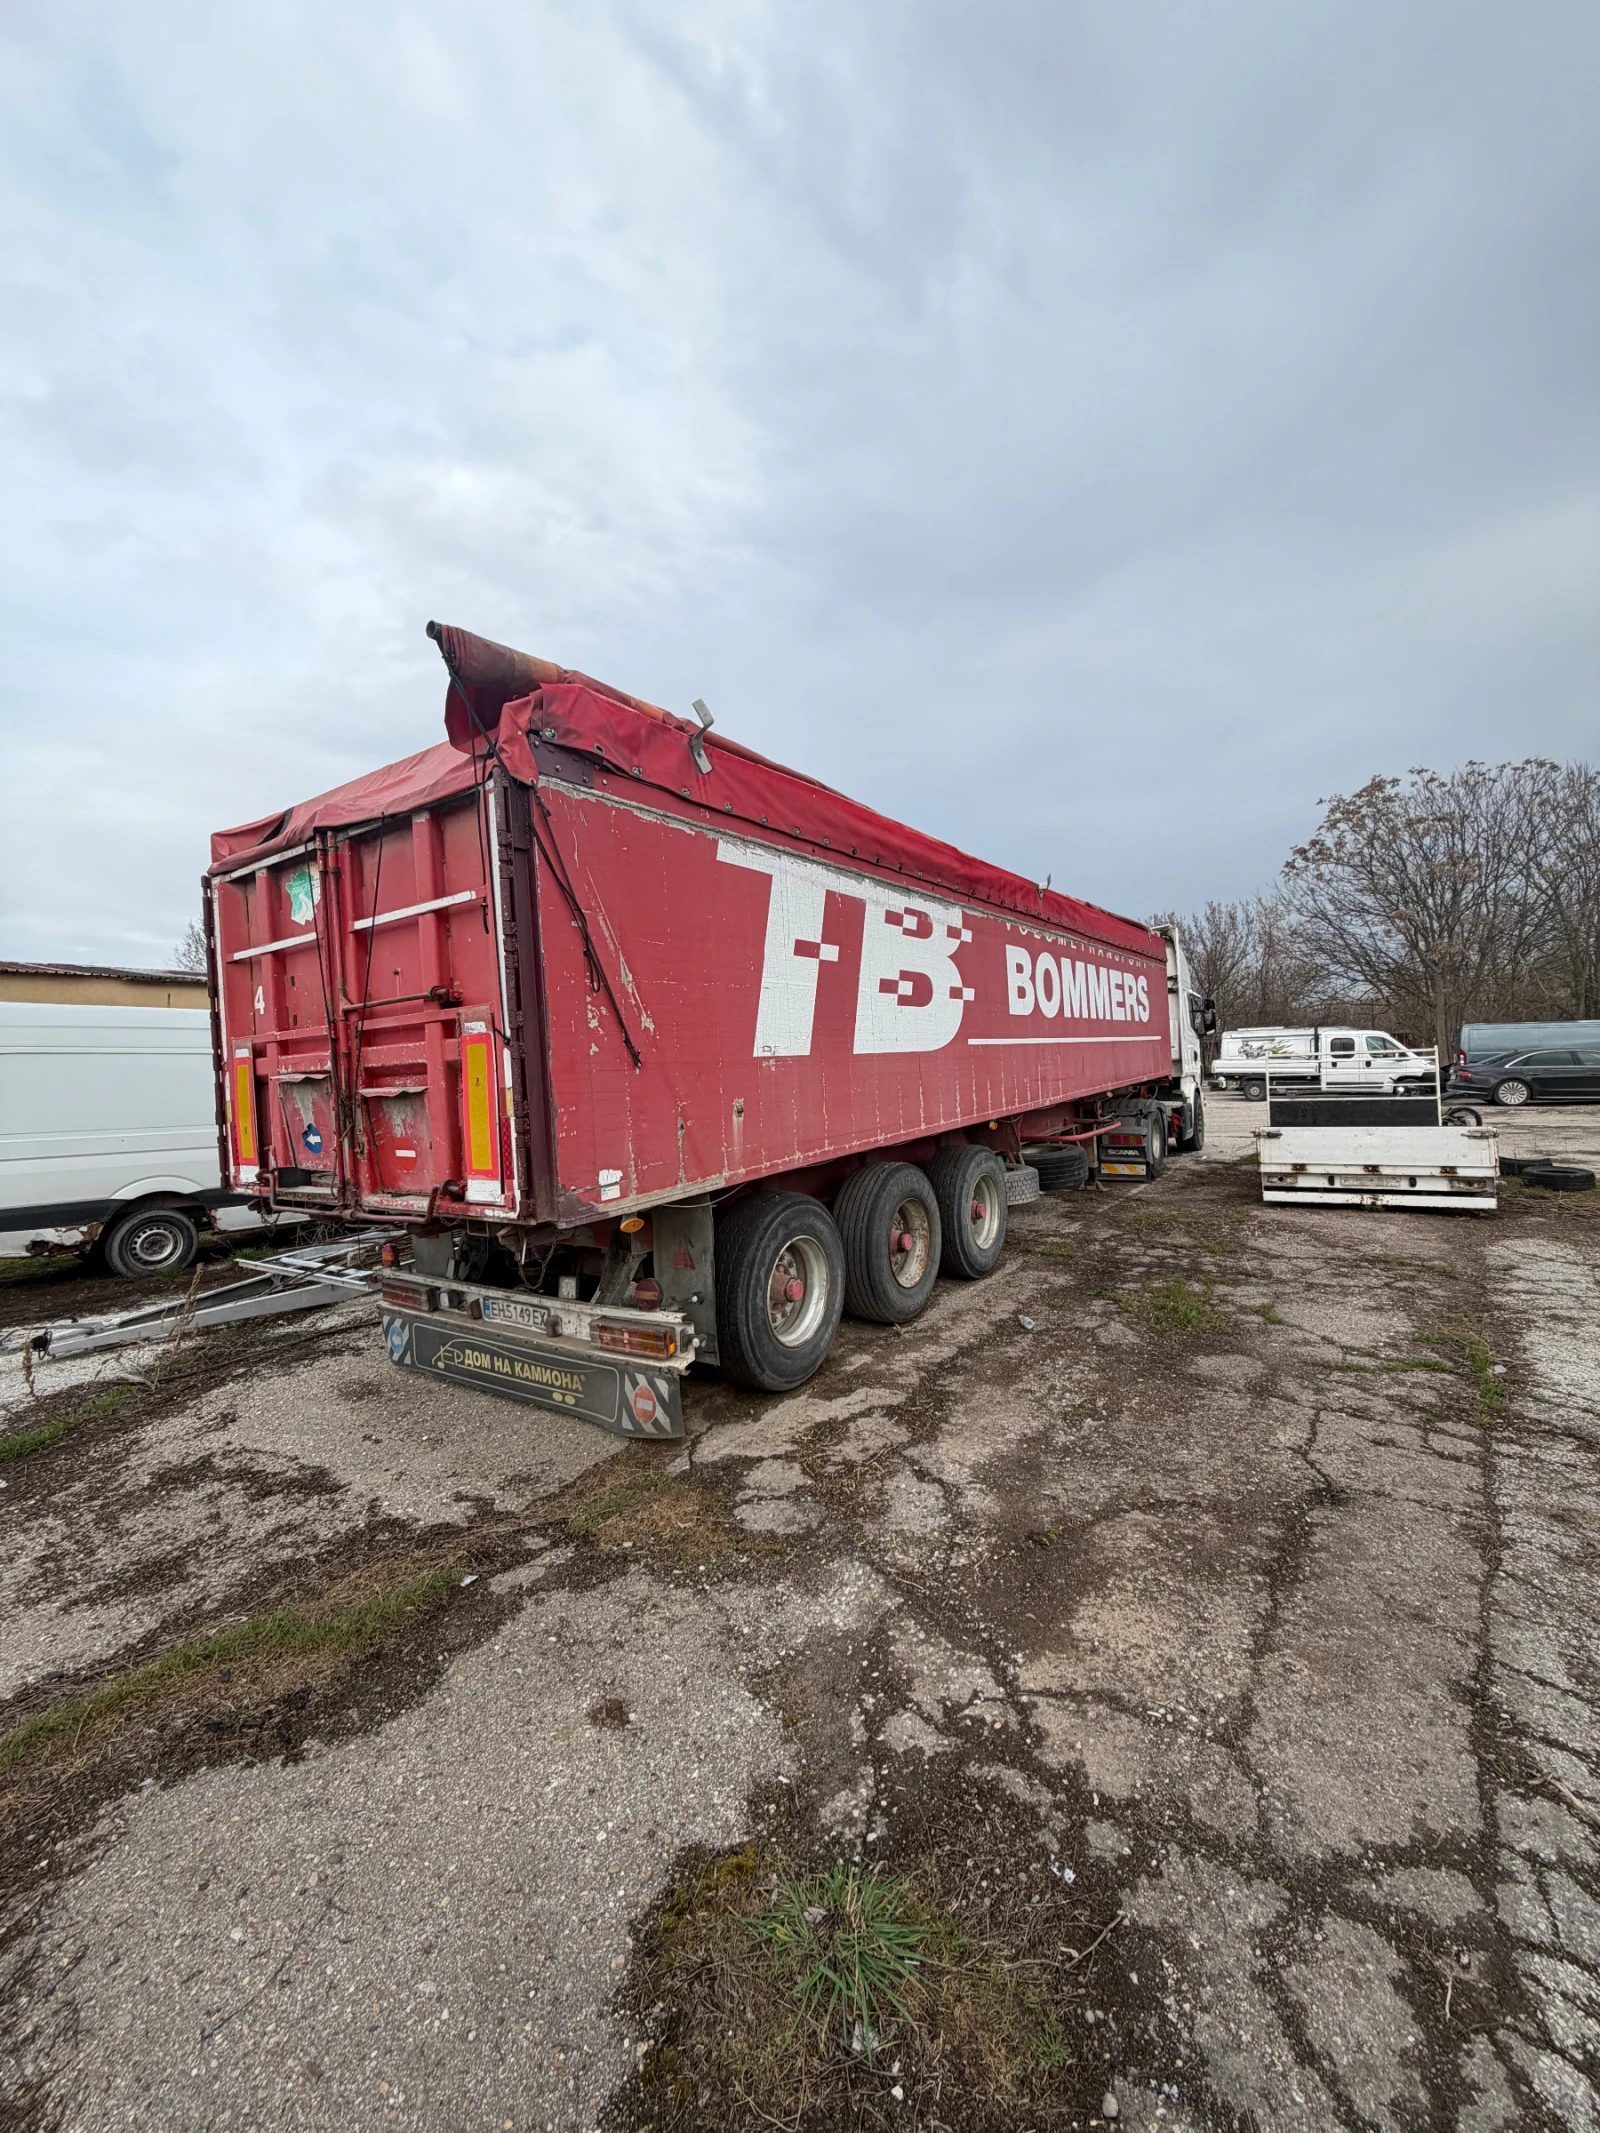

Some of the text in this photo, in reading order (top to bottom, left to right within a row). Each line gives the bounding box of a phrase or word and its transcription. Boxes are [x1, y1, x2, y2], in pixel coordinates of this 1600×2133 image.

[716, 838, 975, 1057] TB
[254, 986, 265, 1014] 4
[1005, 944, 1150, 1022] BOMMERS
[464, 1349, 491, 1369] ДОМ
[494, 1356, 512, 1375] НА
[514, 1361, 583, 1391] КАМИОНА
